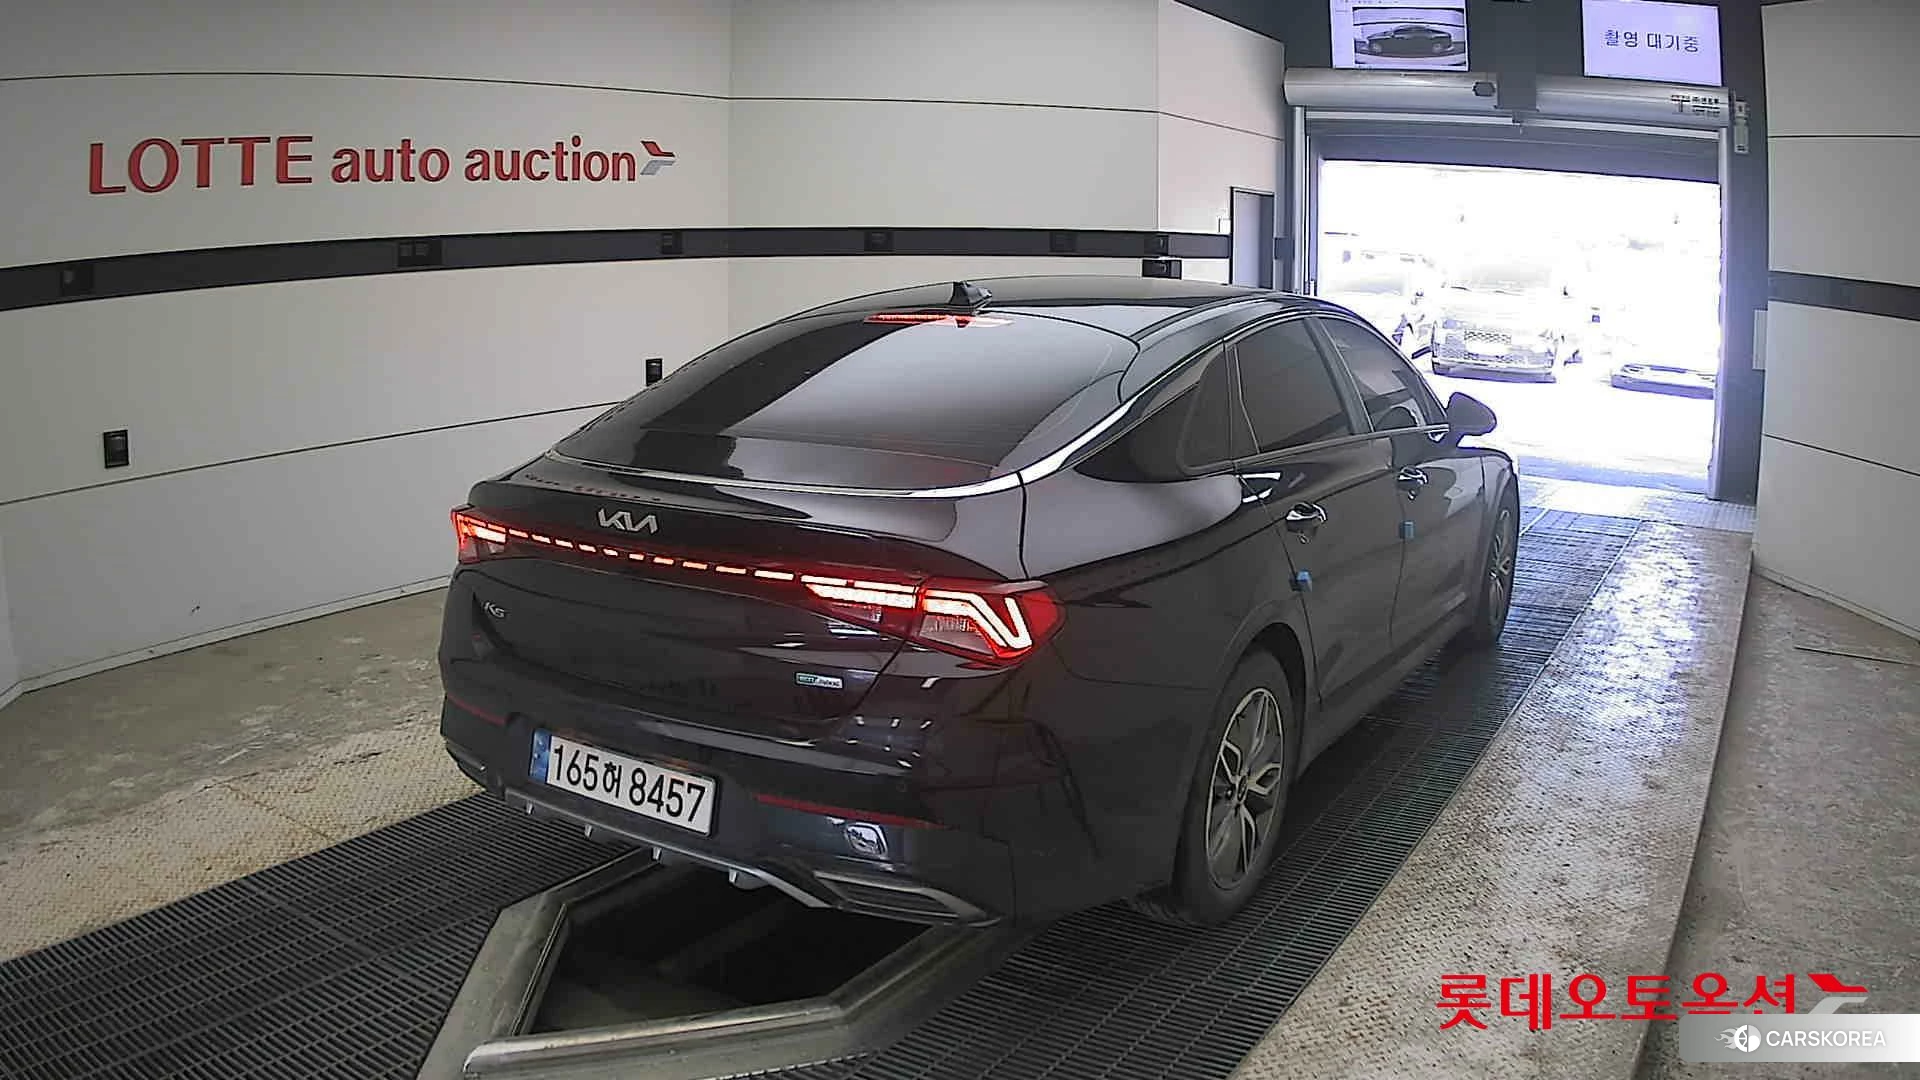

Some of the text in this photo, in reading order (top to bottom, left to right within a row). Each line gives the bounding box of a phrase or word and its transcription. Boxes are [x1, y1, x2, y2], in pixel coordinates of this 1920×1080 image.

[1646, 32, 1698, 53] 대기중
[89, 135, 636, 194] LOTTE auto auction
[598, 508, 658, 534] KIA
[554, 744, 705, 822] 165허 8457
